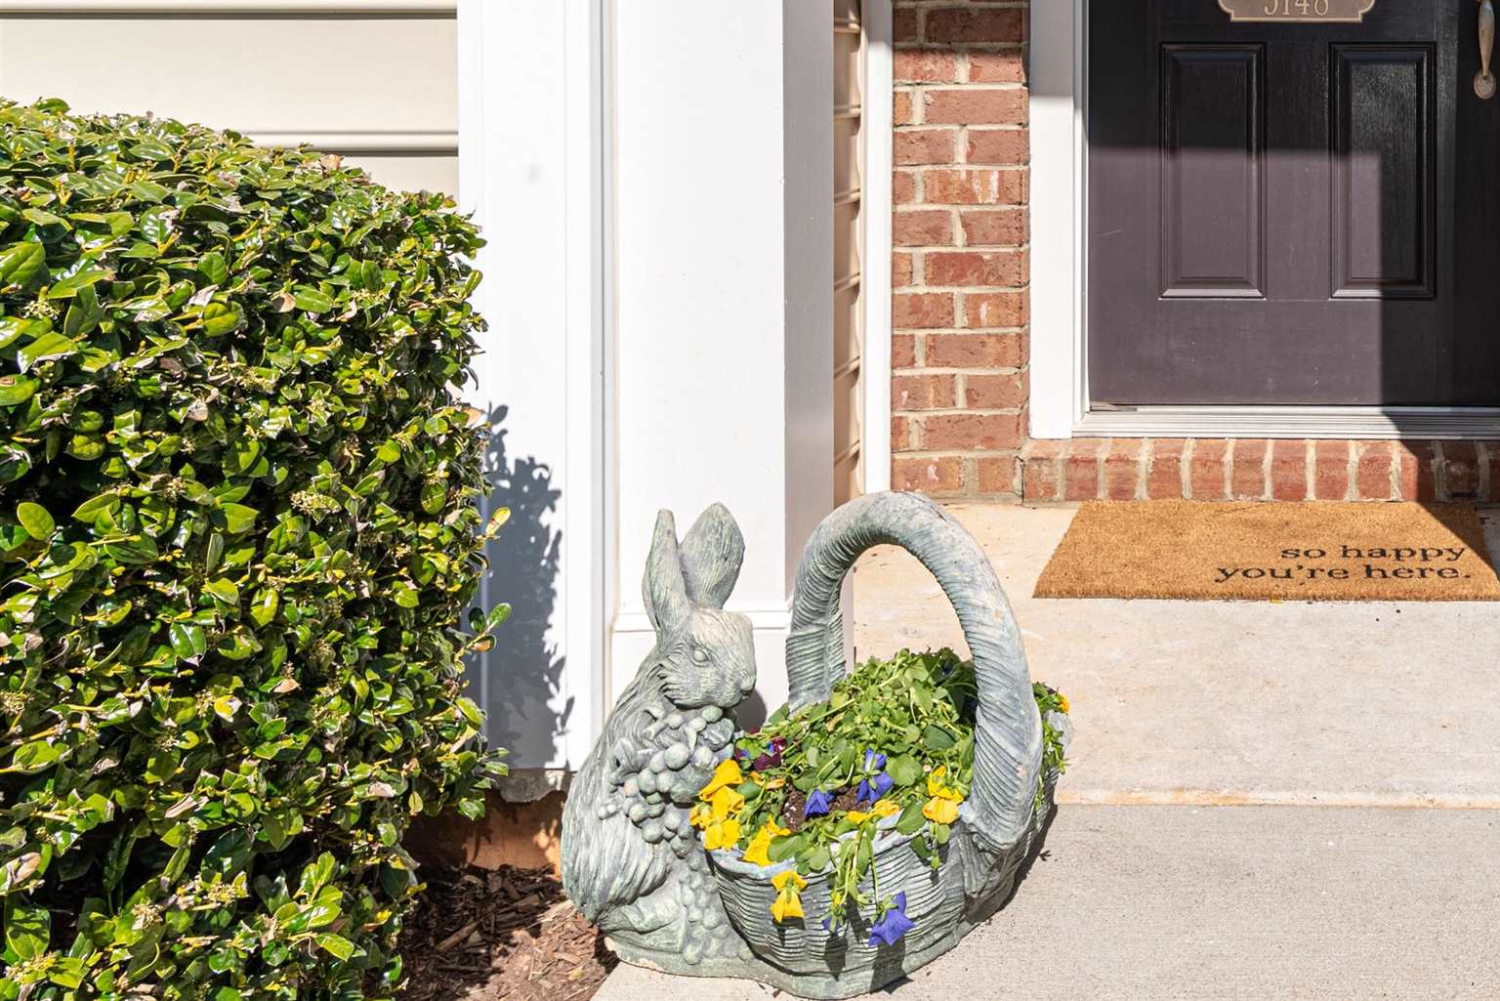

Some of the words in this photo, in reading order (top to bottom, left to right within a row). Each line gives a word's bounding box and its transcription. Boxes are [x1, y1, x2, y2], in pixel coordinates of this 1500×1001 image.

[1280, 547, 1327, 559] so
[1341, 545, 1465, 561] happy
[1214, 564, 1349, 583] you're
[1363, 564, 1471, 580] here.
